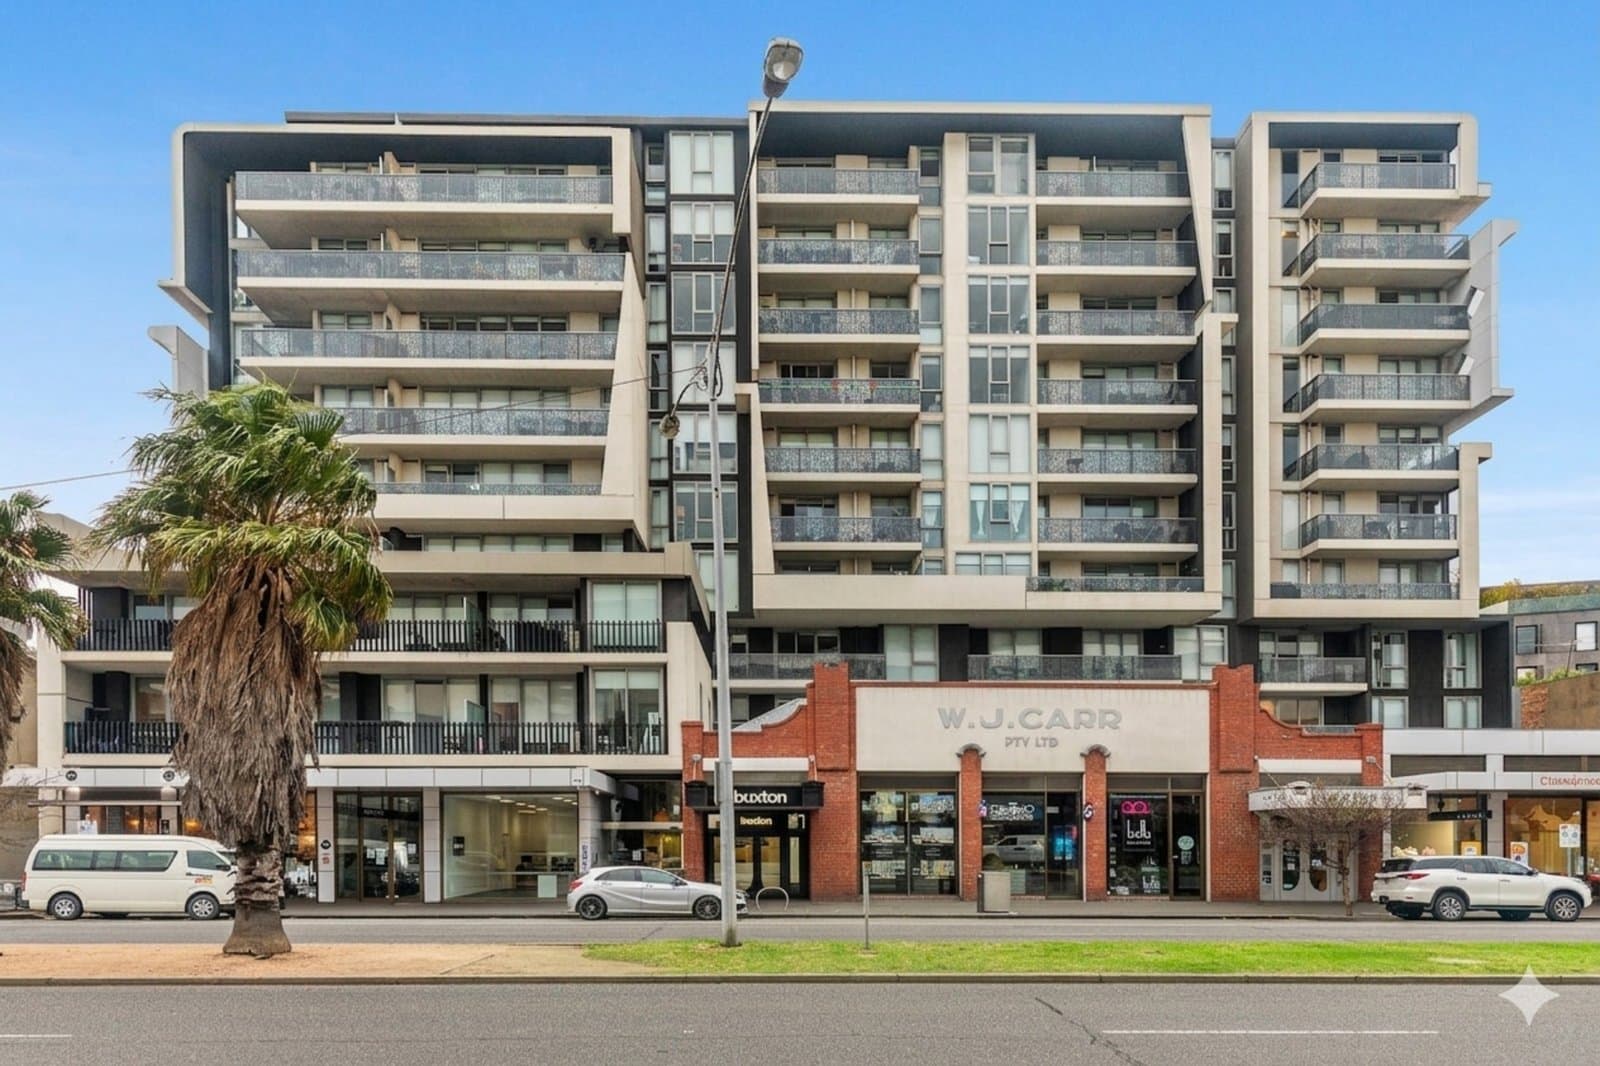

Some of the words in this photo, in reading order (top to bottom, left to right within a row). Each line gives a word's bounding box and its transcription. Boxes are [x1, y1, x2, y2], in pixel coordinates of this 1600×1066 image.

[1005, 737, 1030, 748] PTY
[1035, 737, 1059, 748] LTD
[734, 790, 787, 804] buxton
